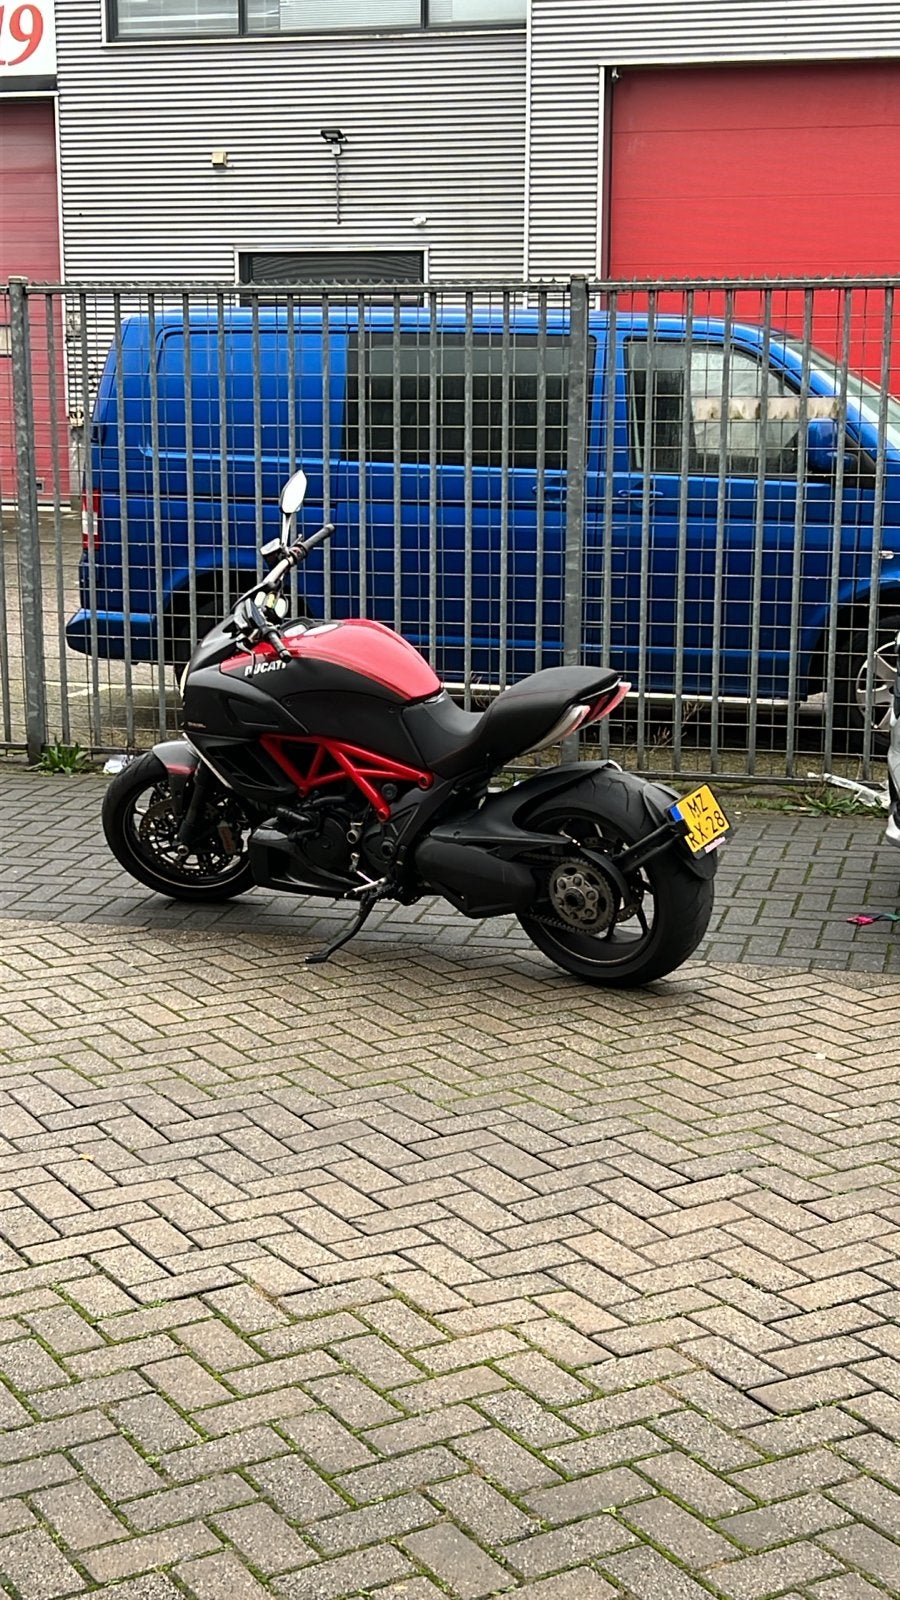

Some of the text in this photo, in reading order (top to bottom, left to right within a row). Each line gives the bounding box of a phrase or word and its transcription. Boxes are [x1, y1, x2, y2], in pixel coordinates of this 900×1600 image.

[245, 660, 286, 677] DUCATI
[686, 793, 708, 819] MZ
[688, 811, 725, 848] RX-28
